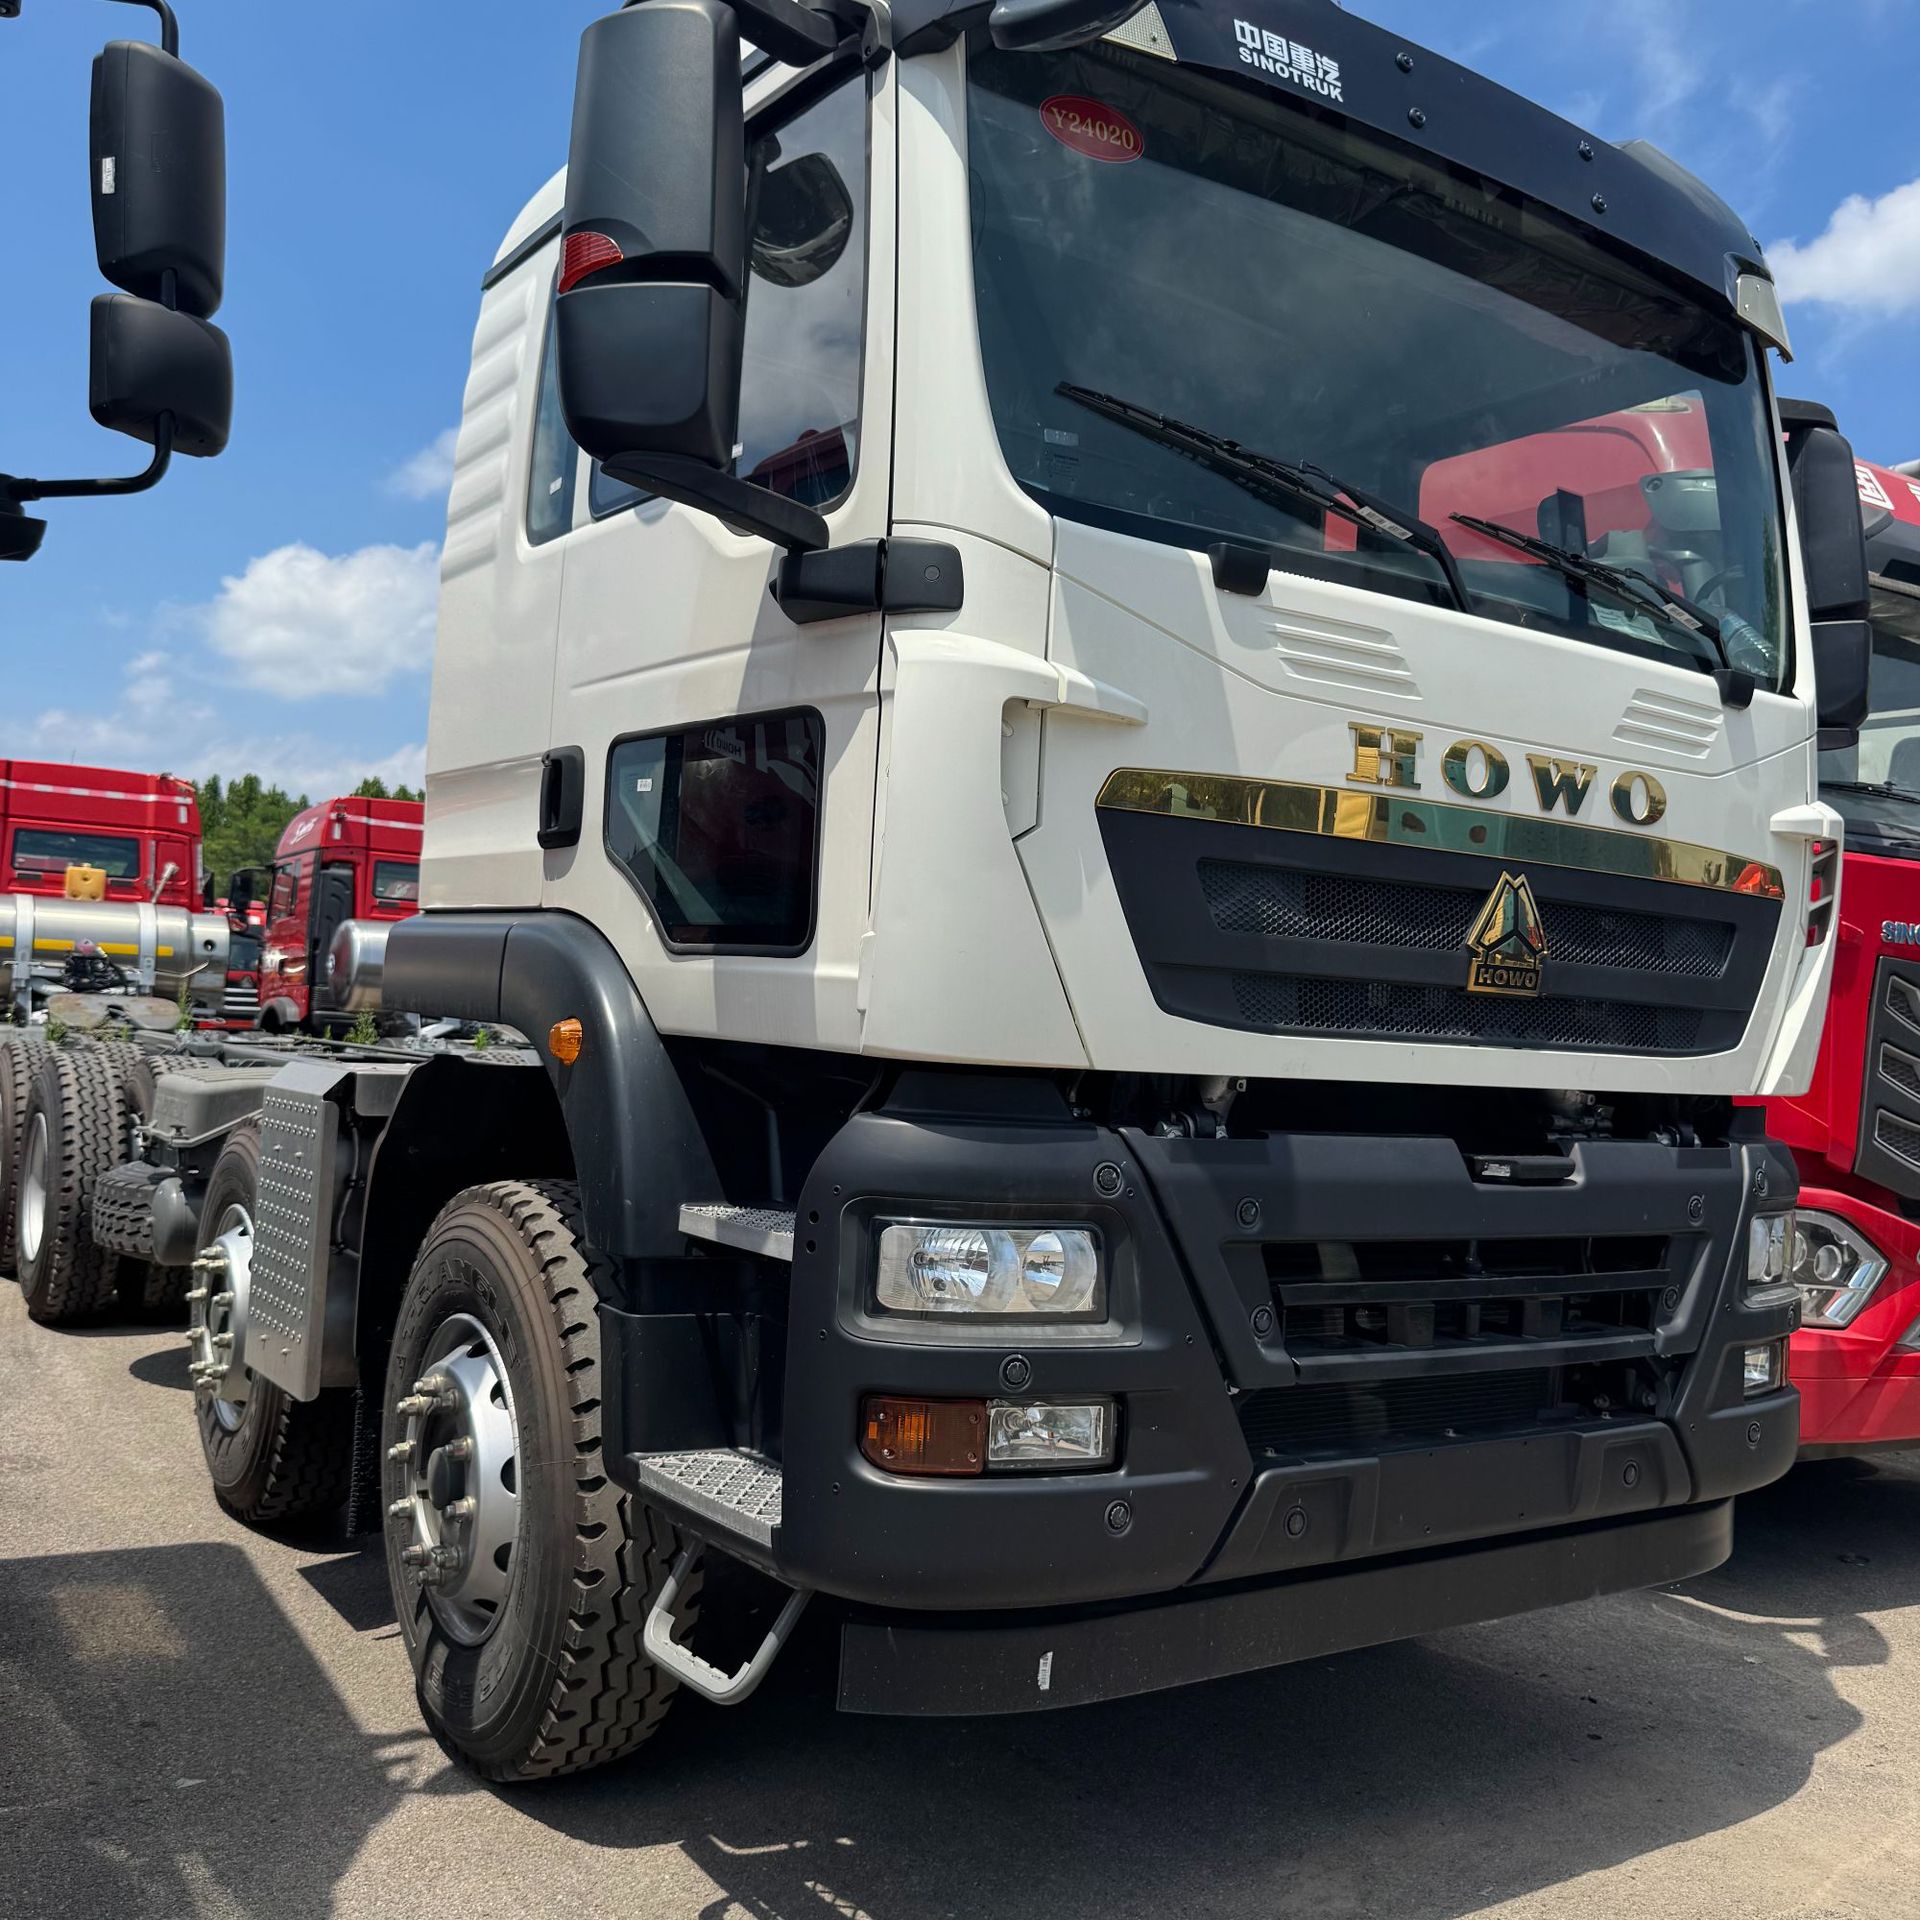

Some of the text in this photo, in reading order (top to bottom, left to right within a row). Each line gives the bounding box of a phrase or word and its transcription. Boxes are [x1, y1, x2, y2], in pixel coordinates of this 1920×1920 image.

[1233, 19, 1341, 87] 中国重汽
[1239, 47, 1343, 103] SINOTRUK
[1050, 107, 1135, 150] Y24020
[1345, 721, 1667, 826] HOWO
[1478, 967, 1537, 988] HOWO
